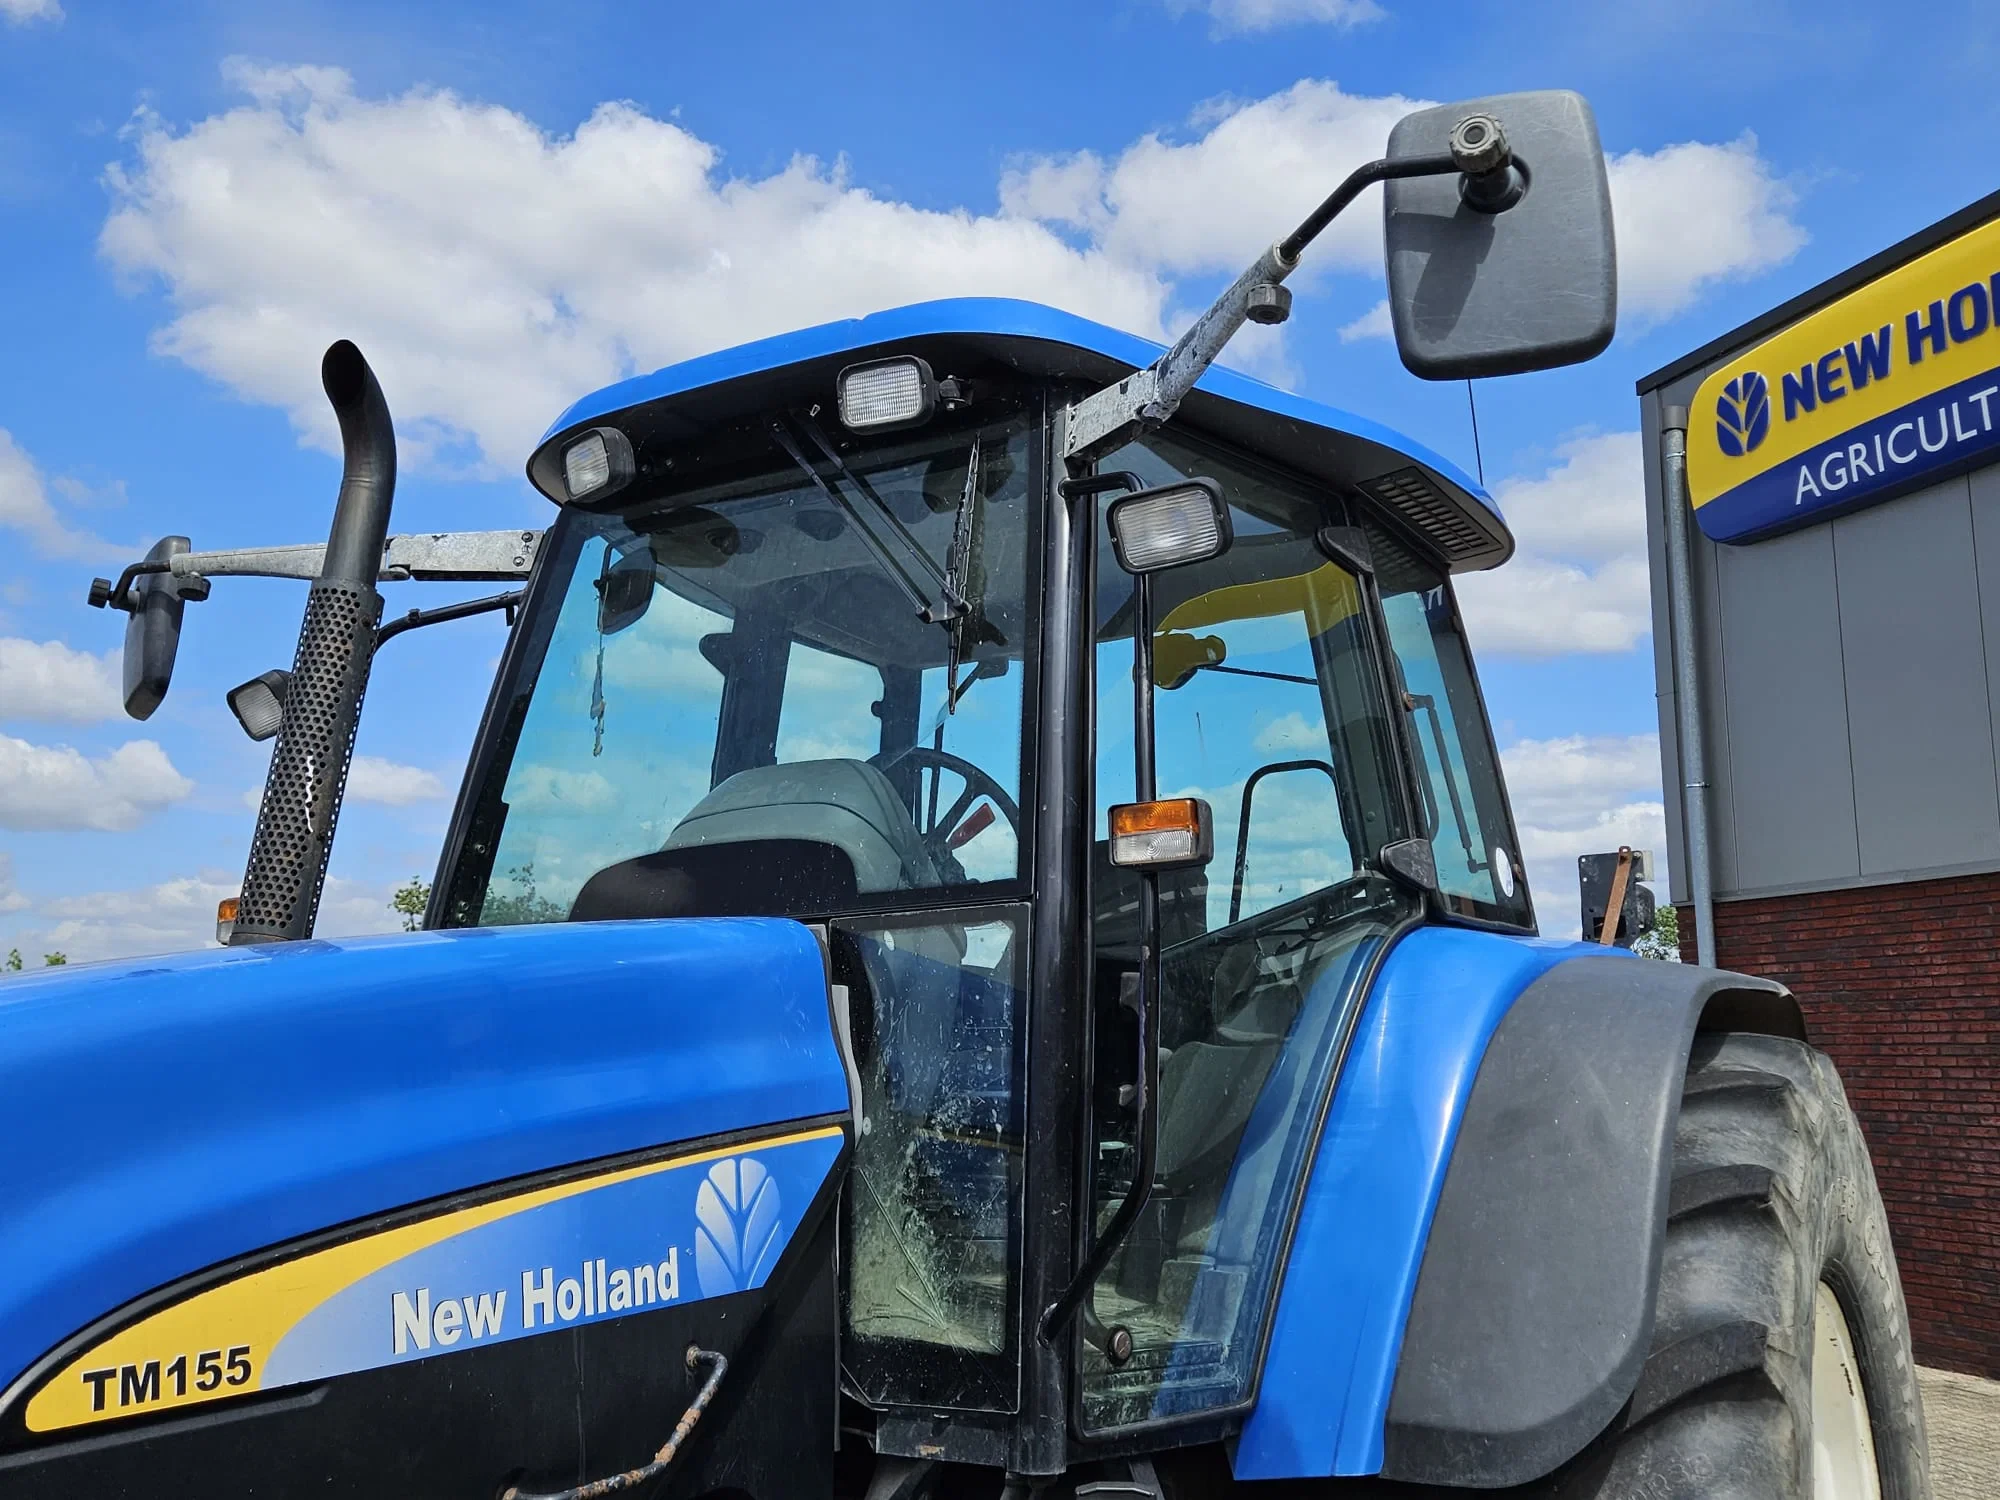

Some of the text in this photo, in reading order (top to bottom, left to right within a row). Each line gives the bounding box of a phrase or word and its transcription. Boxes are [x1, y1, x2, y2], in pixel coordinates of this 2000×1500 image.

[1782, 324, 1894, 422] NEW
[392, 1246, 680, 1354] New Holland
[82, 1344, 253, 1411] TM155
